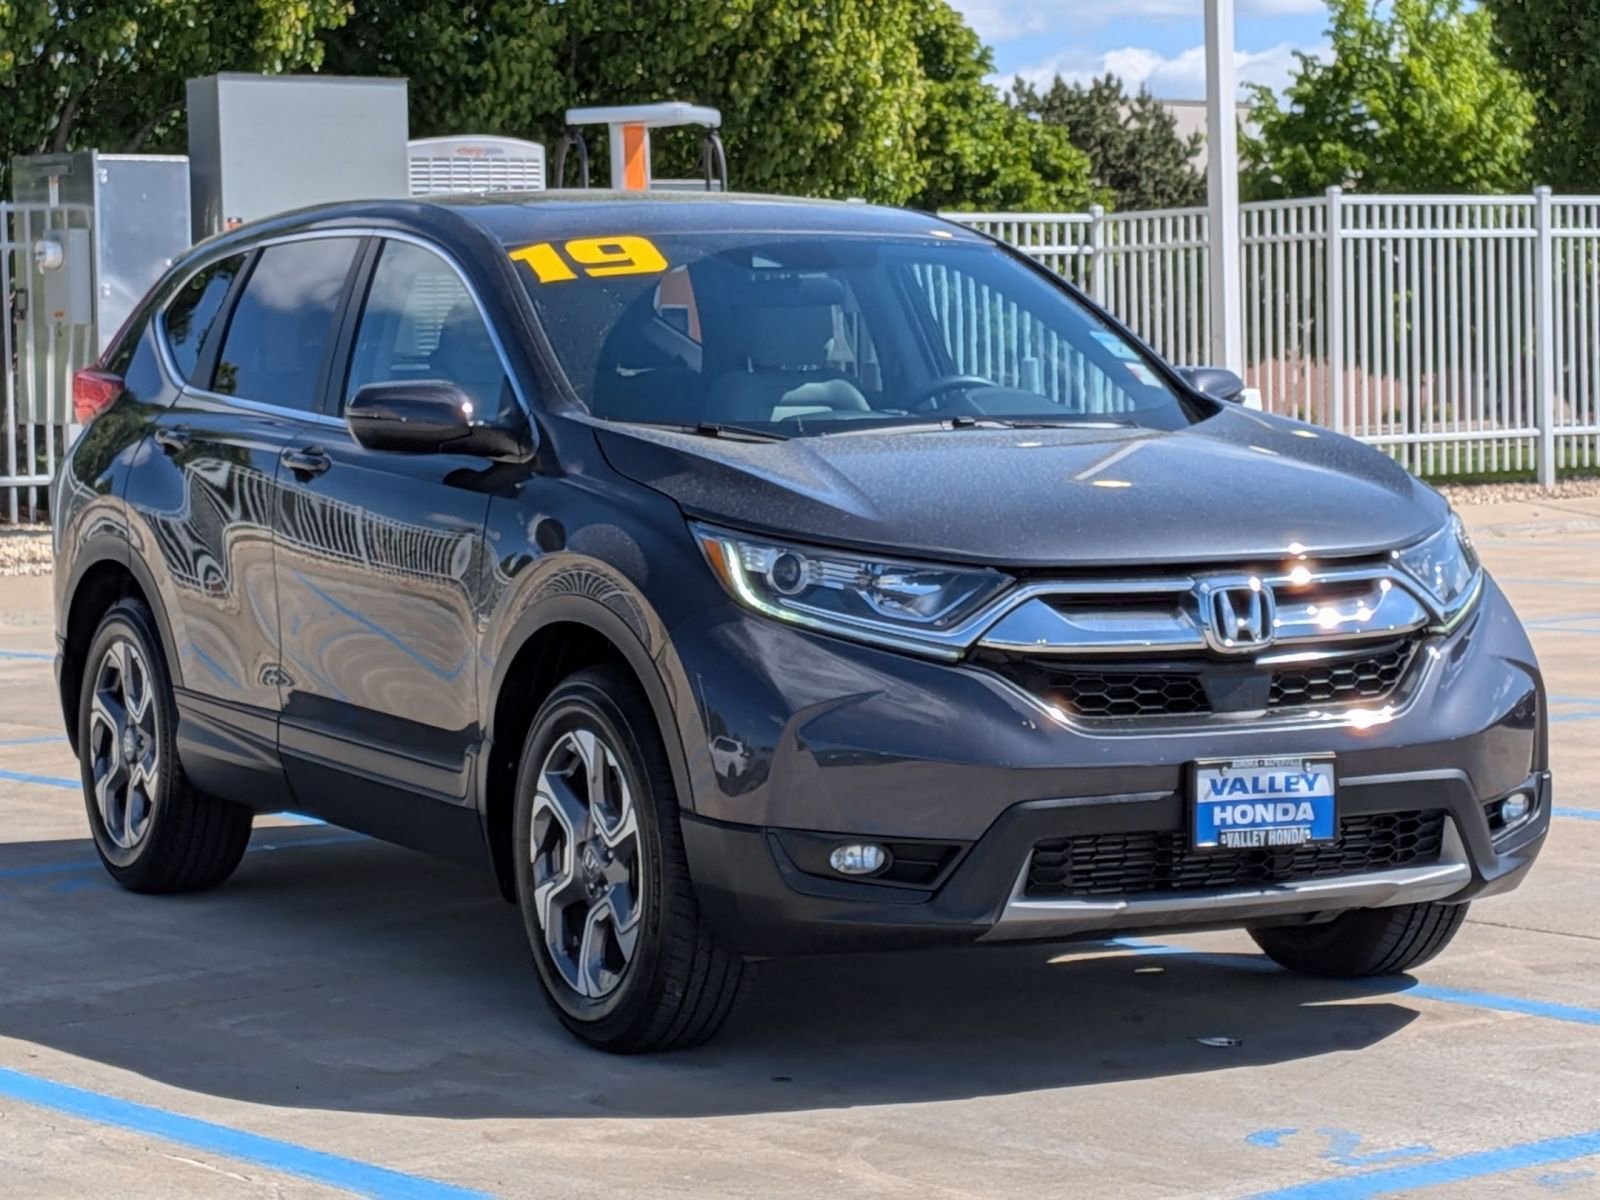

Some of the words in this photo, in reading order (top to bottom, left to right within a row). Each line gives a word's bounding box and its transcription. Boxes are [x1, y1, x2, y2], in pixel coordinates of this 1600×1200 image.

[508, 235, 669, 284] 19
[1210, 773, 1321, 796] VALLEY
[1213, 802, 1315, 826] HONDA
[1226, 831, 1266, 848] VALLEY
[1268, 828, 1306, 845] HONDA
